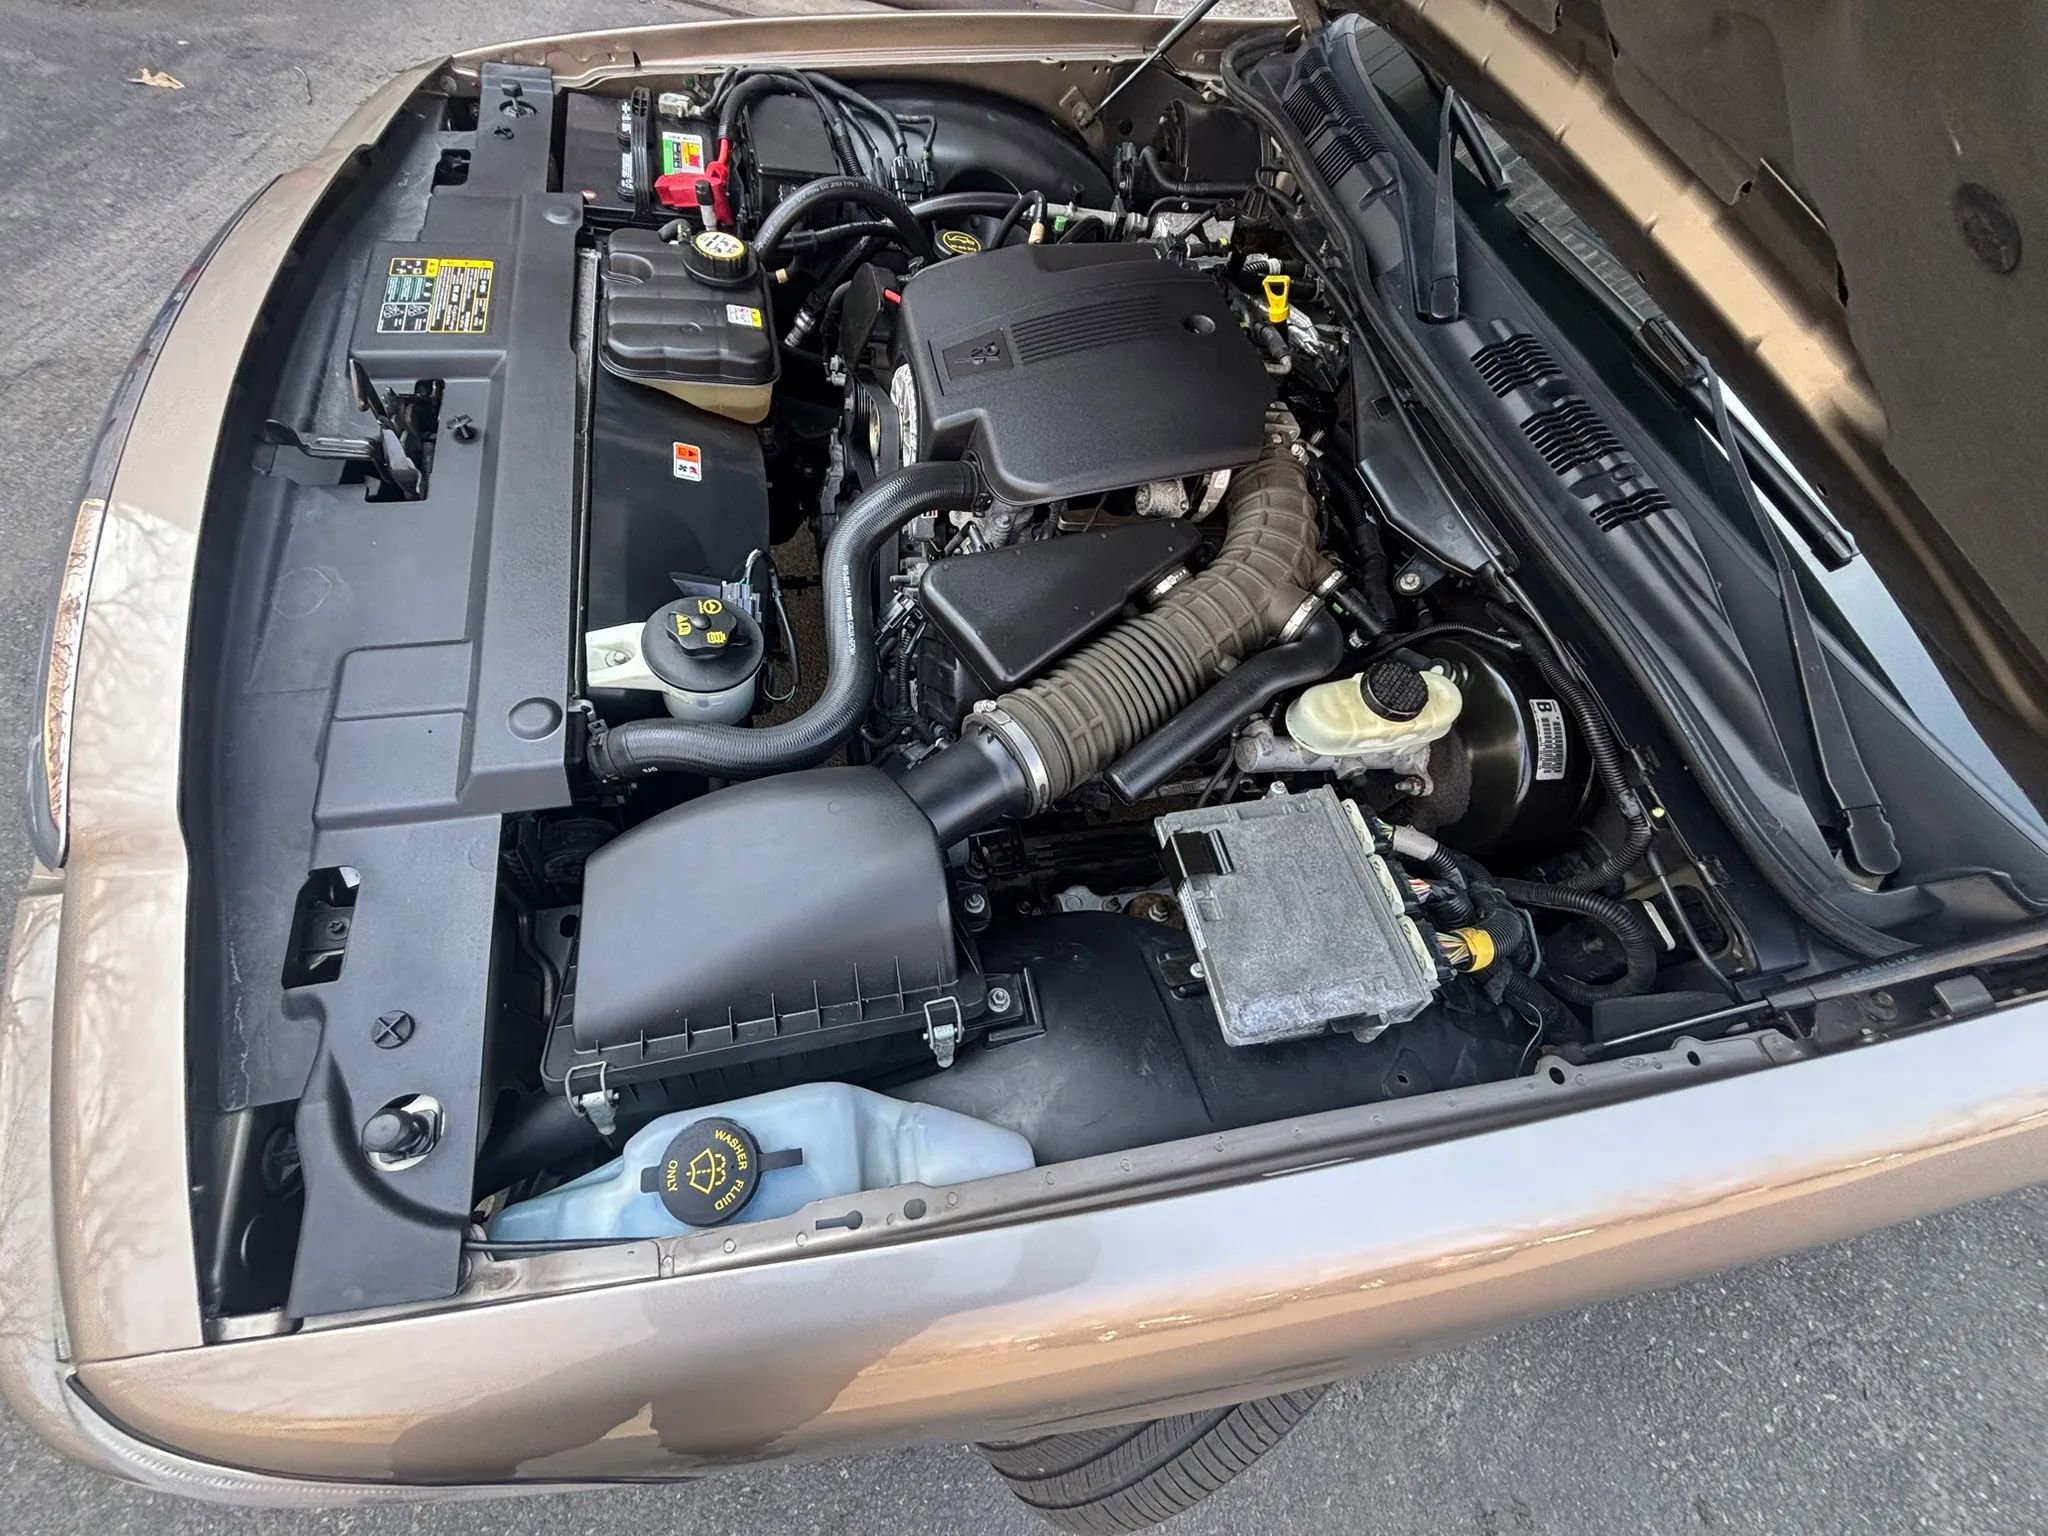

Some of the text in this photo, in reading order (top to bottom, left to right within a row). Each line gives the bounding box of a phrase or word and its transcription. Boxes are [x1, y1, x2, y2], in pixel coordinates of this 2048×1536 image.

[1536, 701, 1553, 714] B
[666, 1159, 679, 1192] ONLY
[714, 1129, 748, 1211] WASHER FLUID
